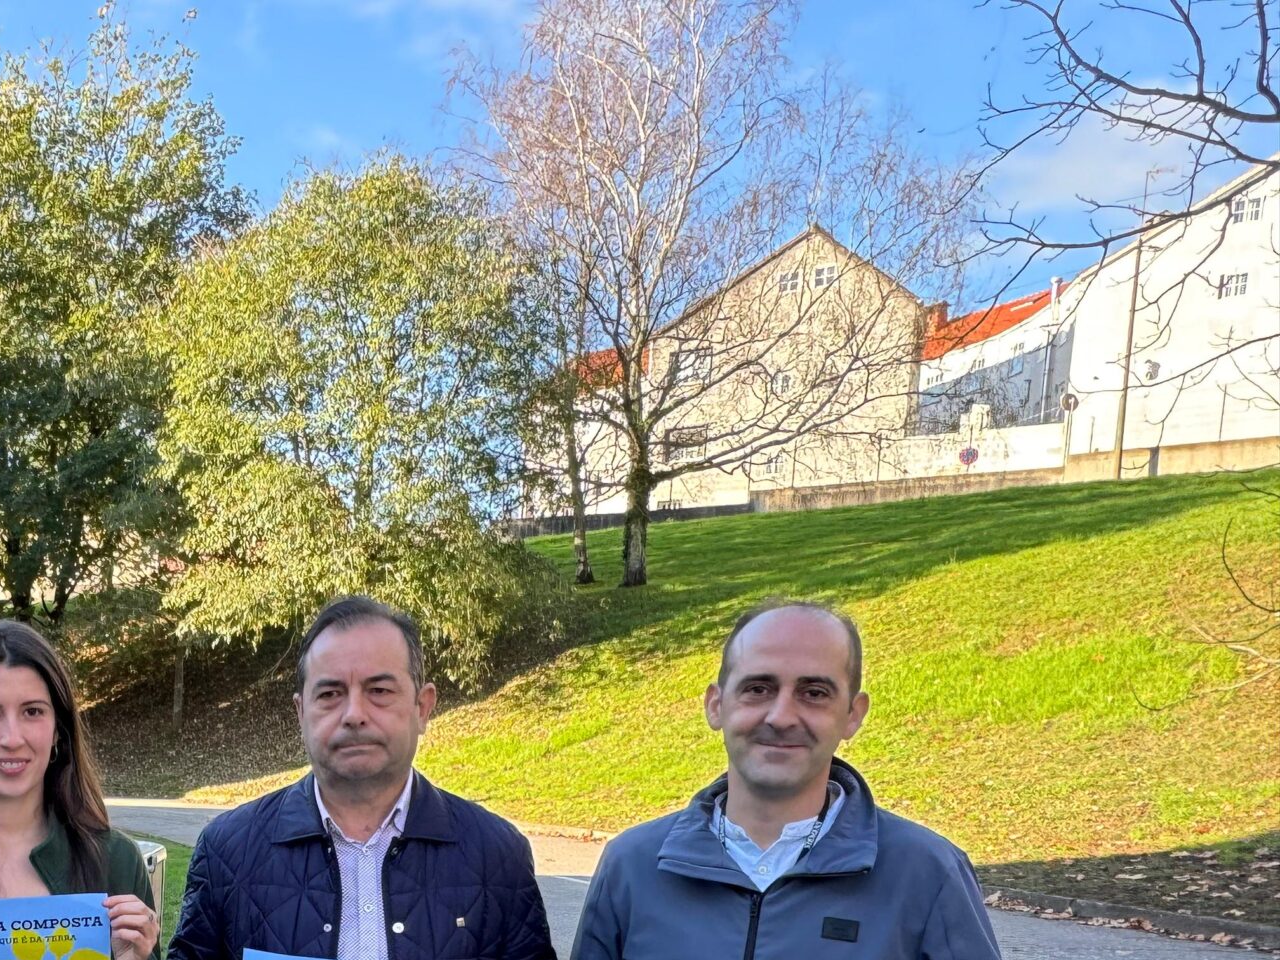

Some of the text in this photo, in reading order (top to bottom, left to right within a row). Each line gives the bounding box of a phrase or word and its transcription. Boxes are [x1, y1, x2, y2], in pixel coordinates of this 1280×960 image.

[11, 916, 103, 931] COMPOSTA
[0, 937, 18, 945] QUE
[21, 935, 28, 944] É
[30, 936, 42, 944] DA
[44, 934, 77, 943] TERRA
